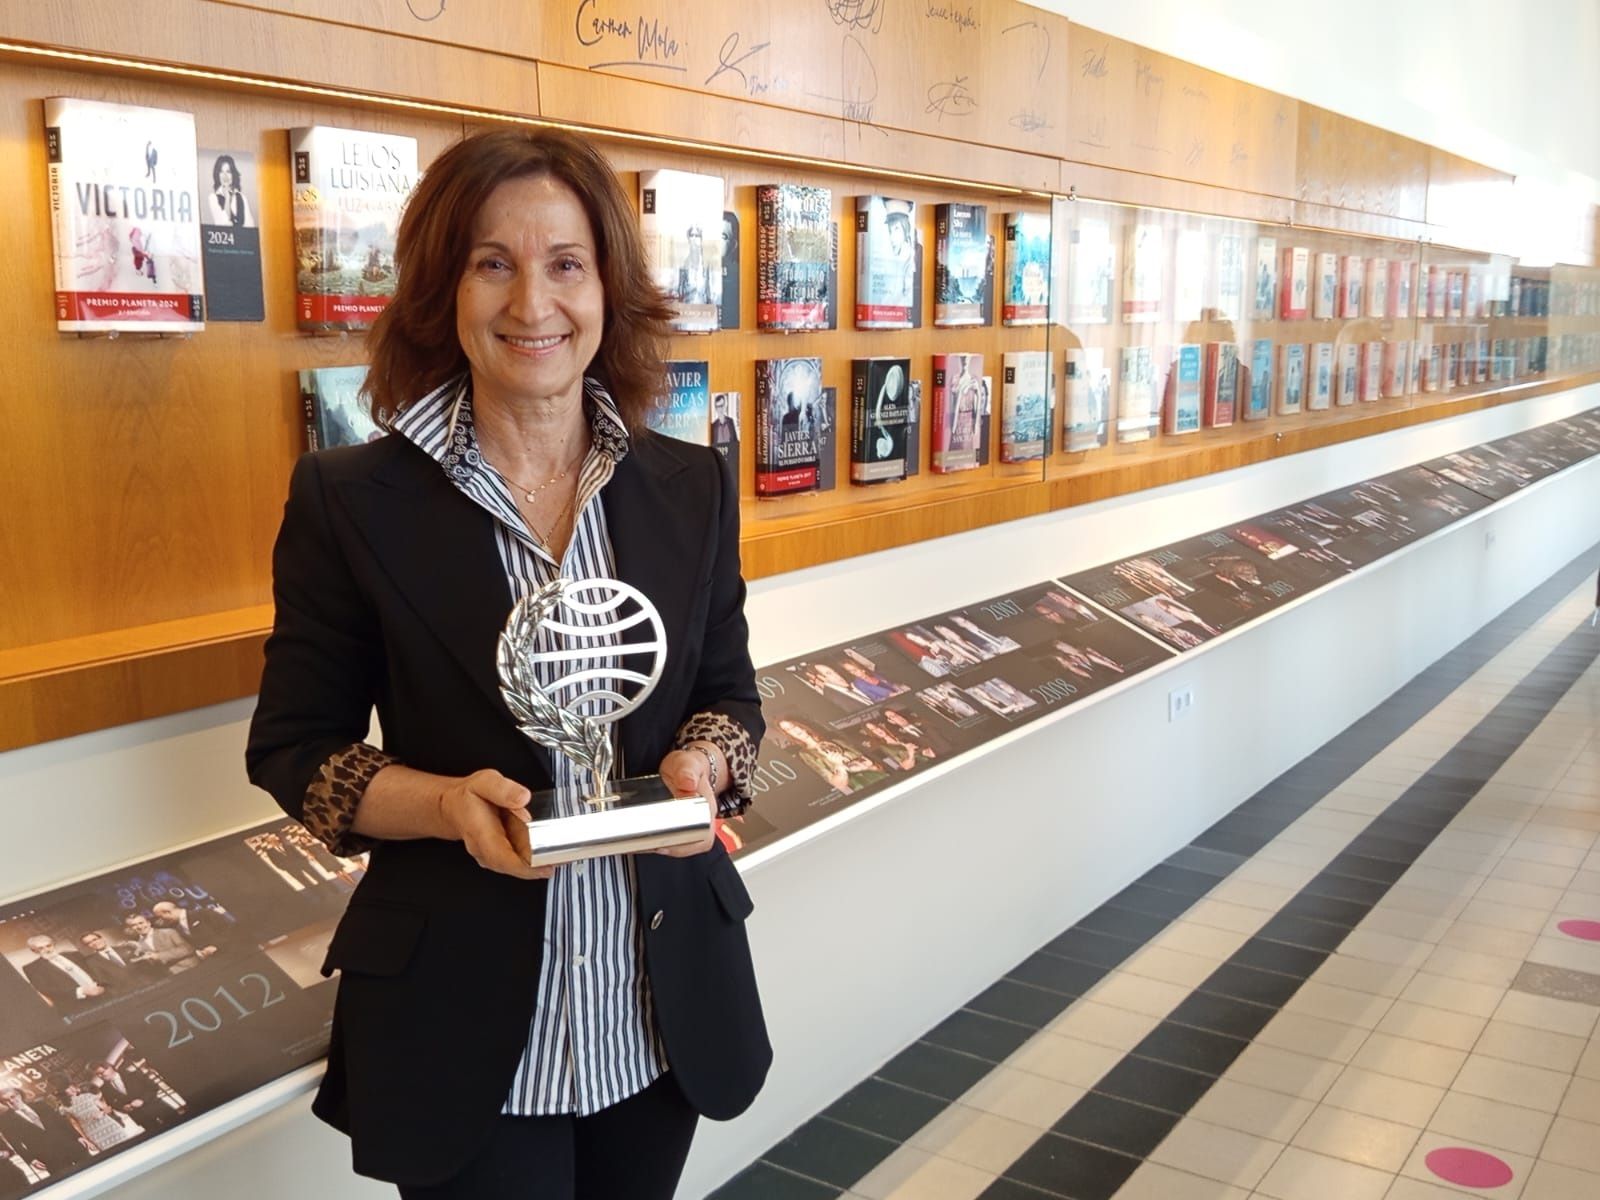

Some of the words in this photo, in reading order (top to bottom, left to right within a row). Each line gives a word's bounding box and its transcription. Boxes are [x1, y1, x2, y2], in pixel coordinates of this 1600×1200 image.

[576, 0, 632, 46] Carmen
[76, 181, 193, 223] VICTORIA
[208, 231, 235, 246] 2024
[86, 297, 119, 307] PREMIO
[121, 298, 157, 308] PLANETA
[333, 304, 358, 313] PREMIO
[359, 304, 385, 313] PLANET
[659, 371, 702, 388] AVIER
[784, 430, 810, 443] JAVIER
[778, 441, 818, 459] SIERRA
[980, 599, 1025, 621] 2007
[755, 675, 786, 698] 09
[1029, 677, 1078, 705] 2008
[750, 759, 797, 797] 010
[144, 972, 286, 1049] 2012
[1, 1043, 57, 1075] ANETA
[3, 1067, 43, 1090] 013
